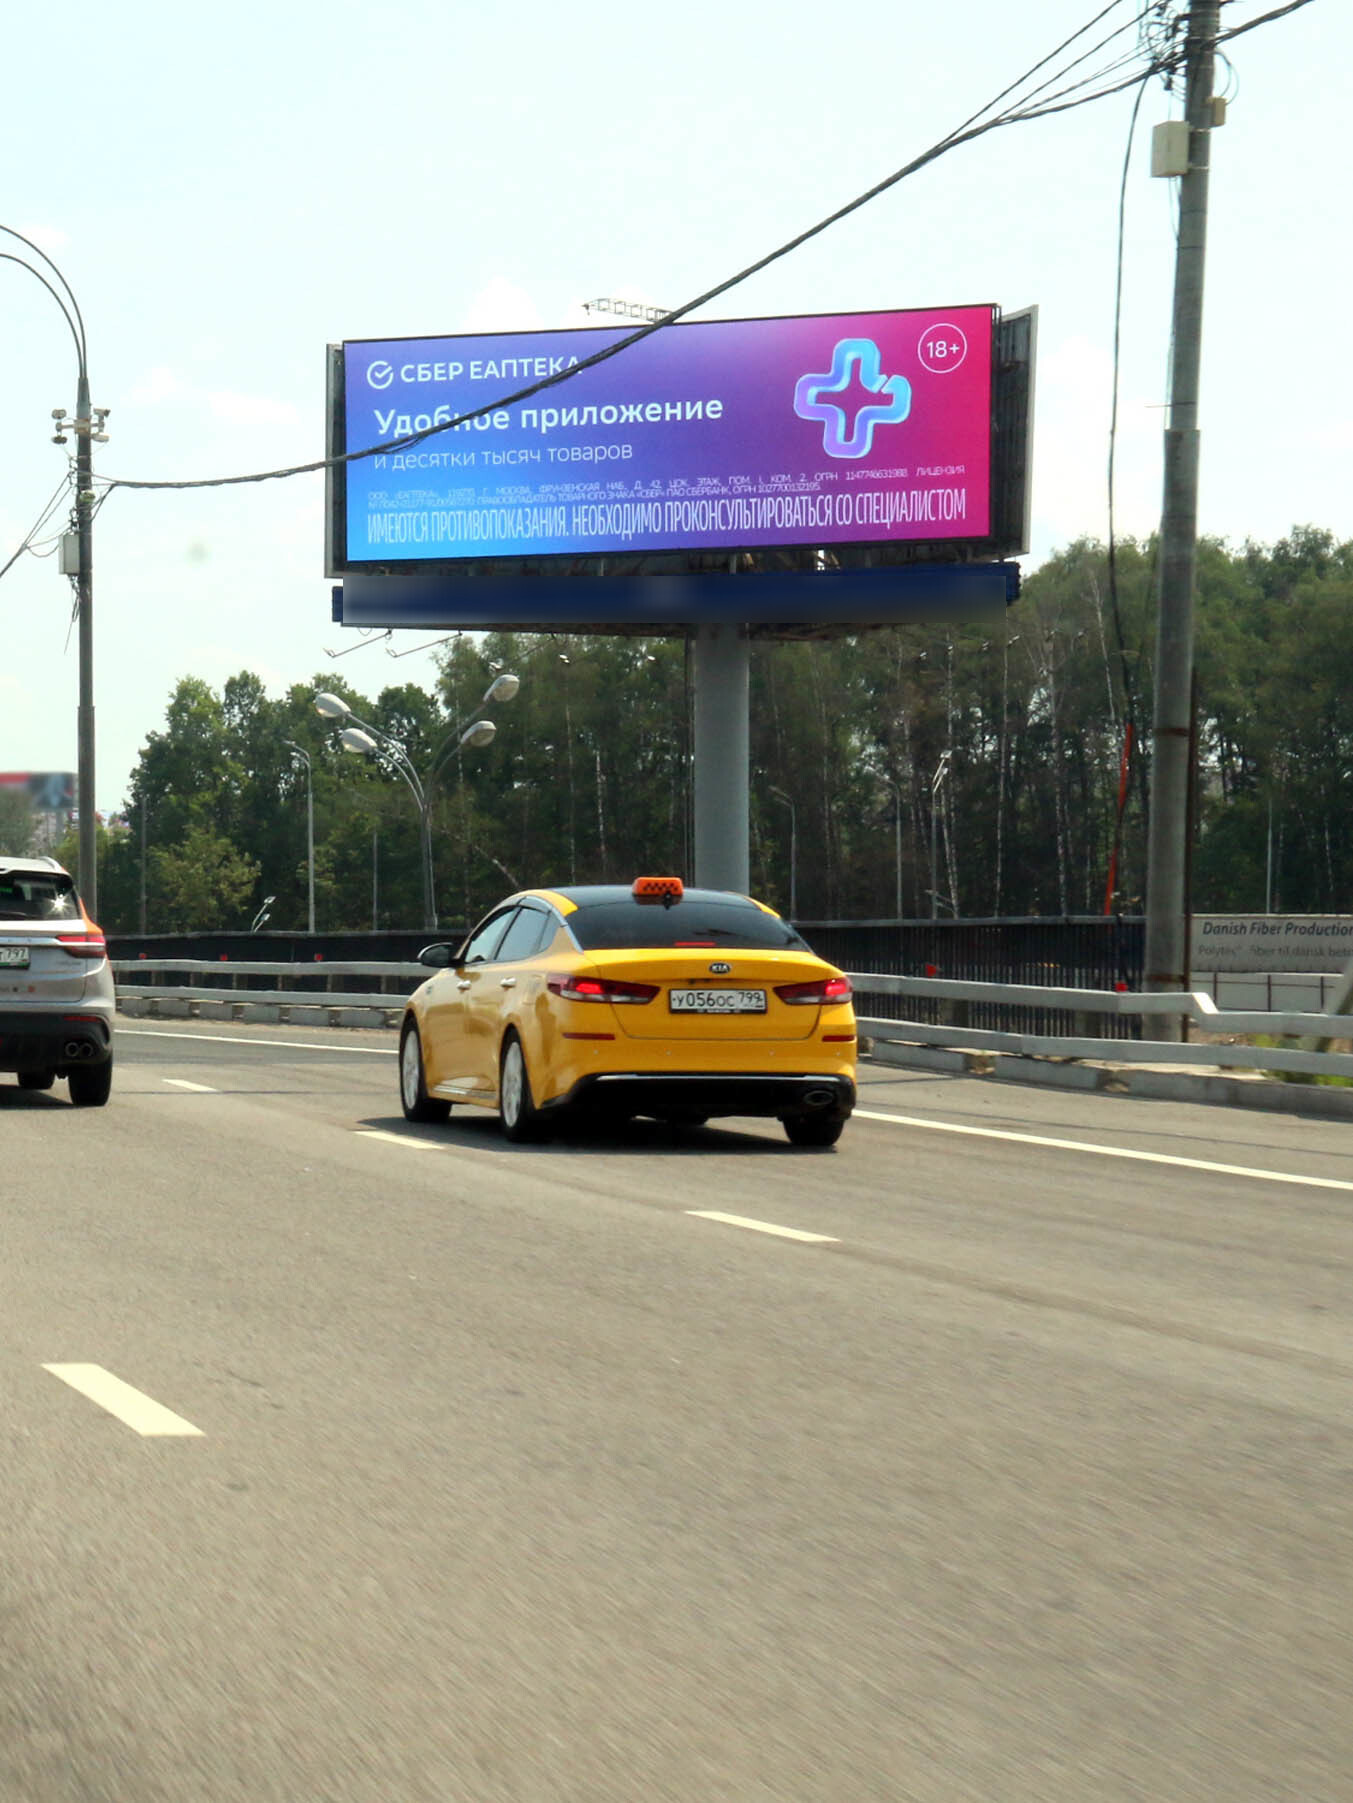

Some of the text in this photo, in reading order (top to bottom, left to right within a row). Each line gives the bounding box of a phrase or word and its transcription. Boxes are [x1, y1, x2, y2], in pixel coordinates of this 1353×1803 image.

[926, 340, 960, 358] 18+
[400, 356, 583, 383] СБЕР ЕАПТЕКА
[520, 399, 724, 434] приложение
[374, 444, 633, 471] и десятки тысяч товаров
[368, 488, 966, 544] ИМЕЮТСЯ ПРОТИВОПОКАЗАНИЯ. НЕОБХОДИМО ПРОКОНСУЛЬТИРОВАТЬСЯ СО СПЕЦИАЛИСТОМ
[1202, 921, 1247, 935] Danish
[1249, 922, 1282, 935] Fiber
[711, 963, 729, 972] KIA
